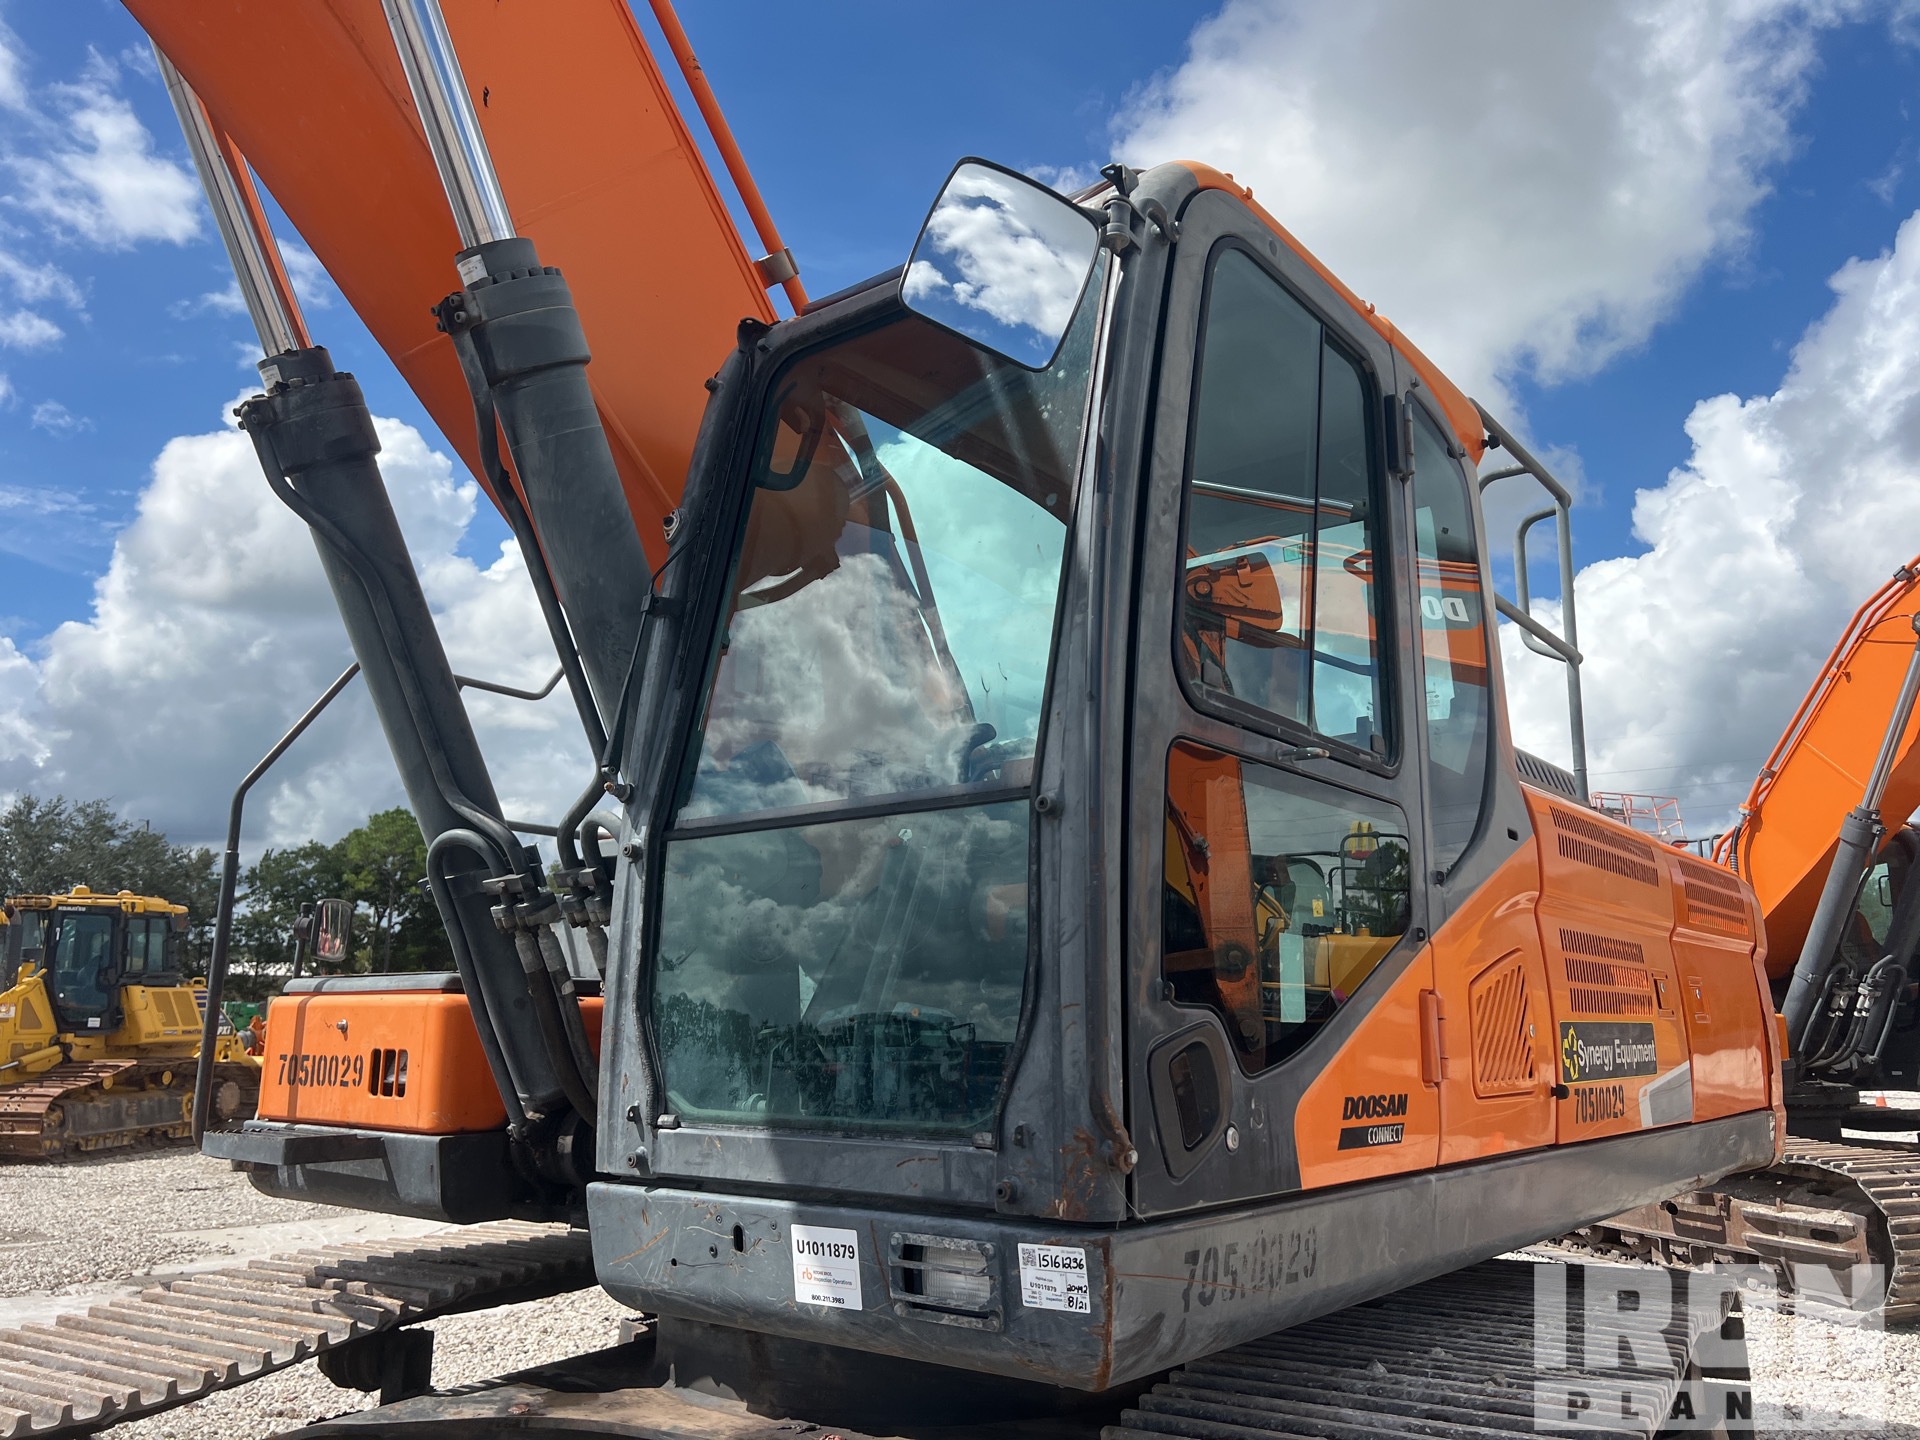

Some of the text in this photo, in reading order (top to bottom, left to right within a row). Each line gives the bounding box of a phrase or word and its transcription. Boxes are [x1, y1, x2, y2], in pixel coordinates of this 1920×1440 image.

[1577, 1038, 1656, 1073] Synergy Equipment
[278, 1054, 364, 1087] 70510029
[1342, 1093, 1408, 1120] DOOSAN
[1574, 1084, 1625, 1124] 70510029
[1367, 1124, 1403, 1144] CONNECT
[796, 1239, 856, 1260] U1011879
[1038, 1253, 1085, 1270] 15161236
[811, 1294, 845, 1305] 800.211.3983
[1068, 1296, 1087, 1310] 8/21
